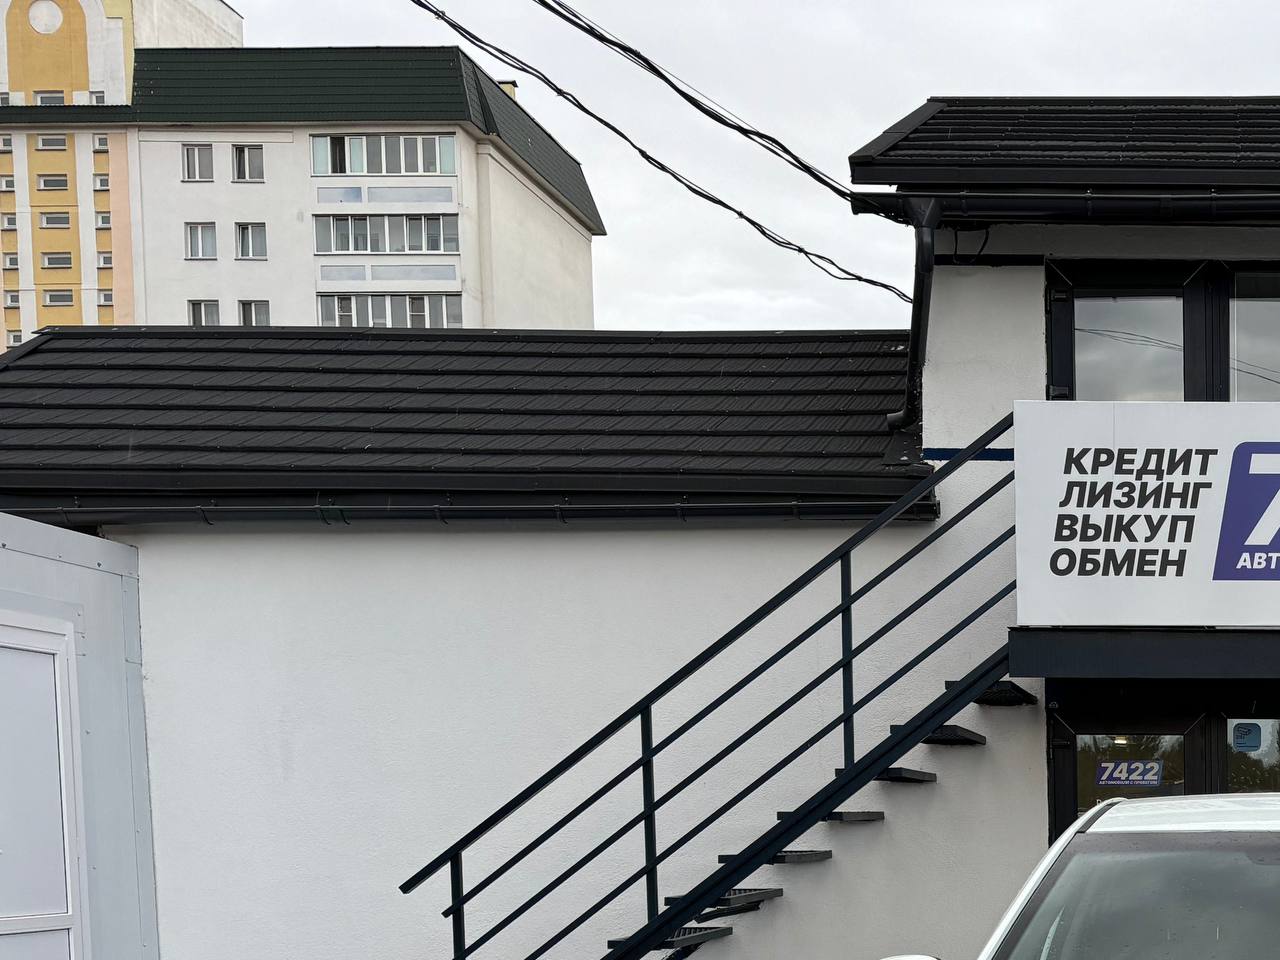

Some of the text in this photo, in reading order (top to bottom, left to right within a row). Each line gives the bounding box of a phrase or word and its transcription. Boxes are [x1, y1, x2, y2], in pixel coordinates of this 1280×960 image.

[1063, 447, 1219, 481] КРЕДИТ
[1058, 481, 1213, 509] ЛИЗИНГ
[1053, 513, 1195, 543] ВЫКУП
[1048, 547, 1187, 577] ОБМЕН
[1100, 762, 1160, 781] 7422
